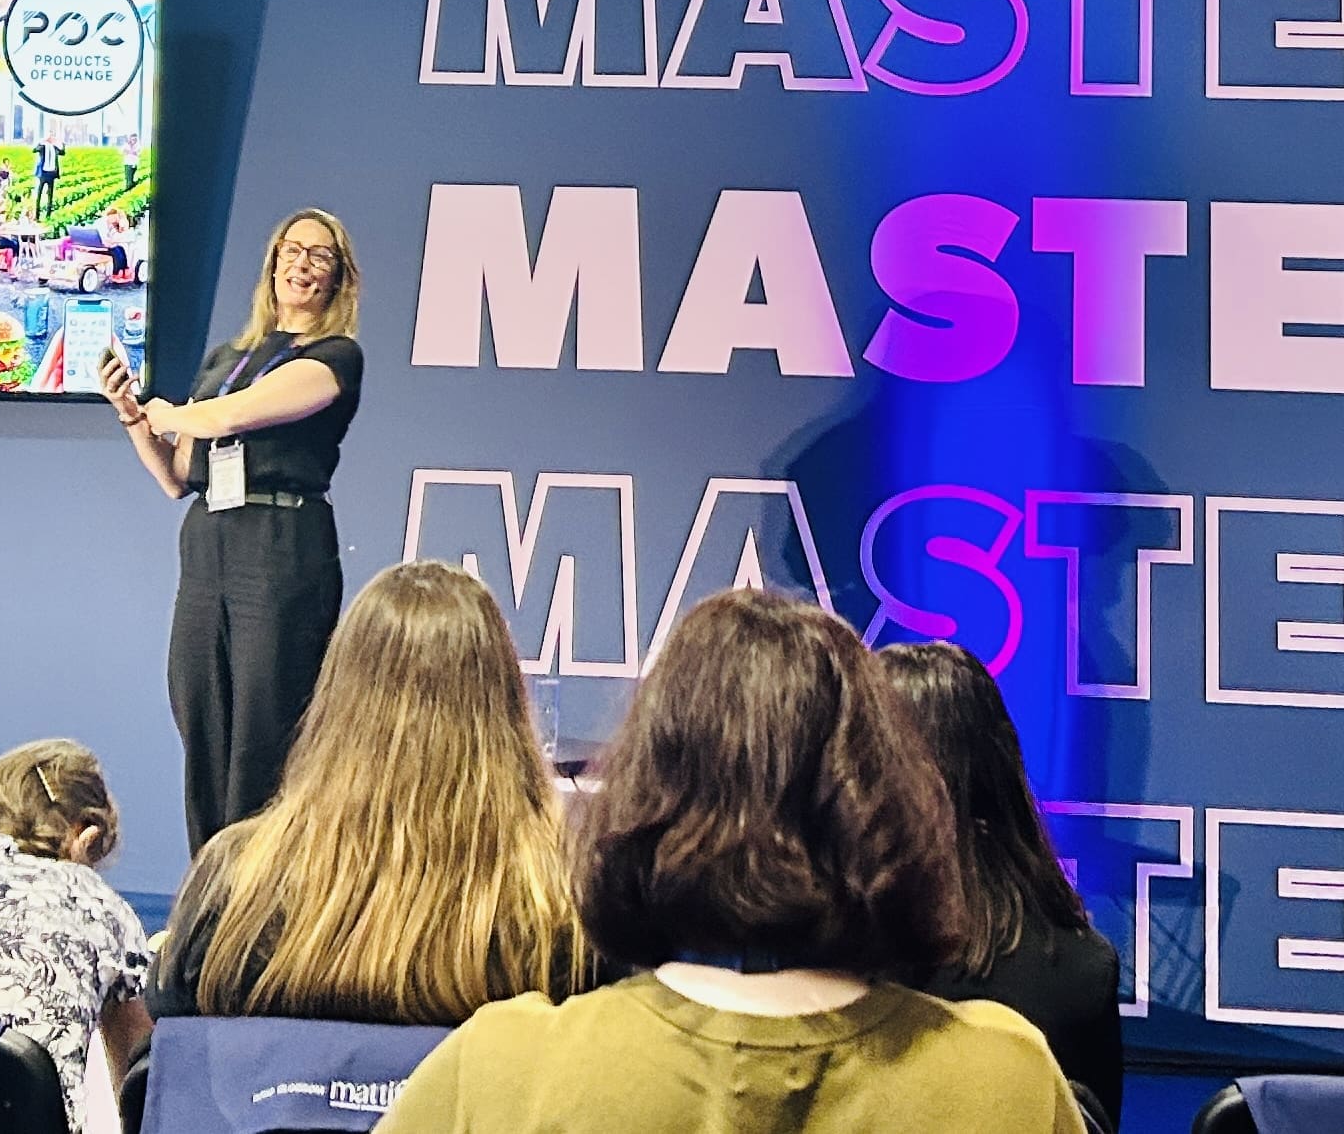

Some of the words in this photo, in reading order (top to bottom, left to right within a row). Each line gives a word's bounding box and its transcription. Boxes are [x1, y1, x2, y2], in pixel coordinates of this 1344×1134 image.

[16, 10, 126, 48] POC
[34, 54, 111, 67] PRODUCTS
[30, 69, 48, 81] OF
[53, 69, 113, 82] CHANGE
[328, 1079, 408, 1106] matti
